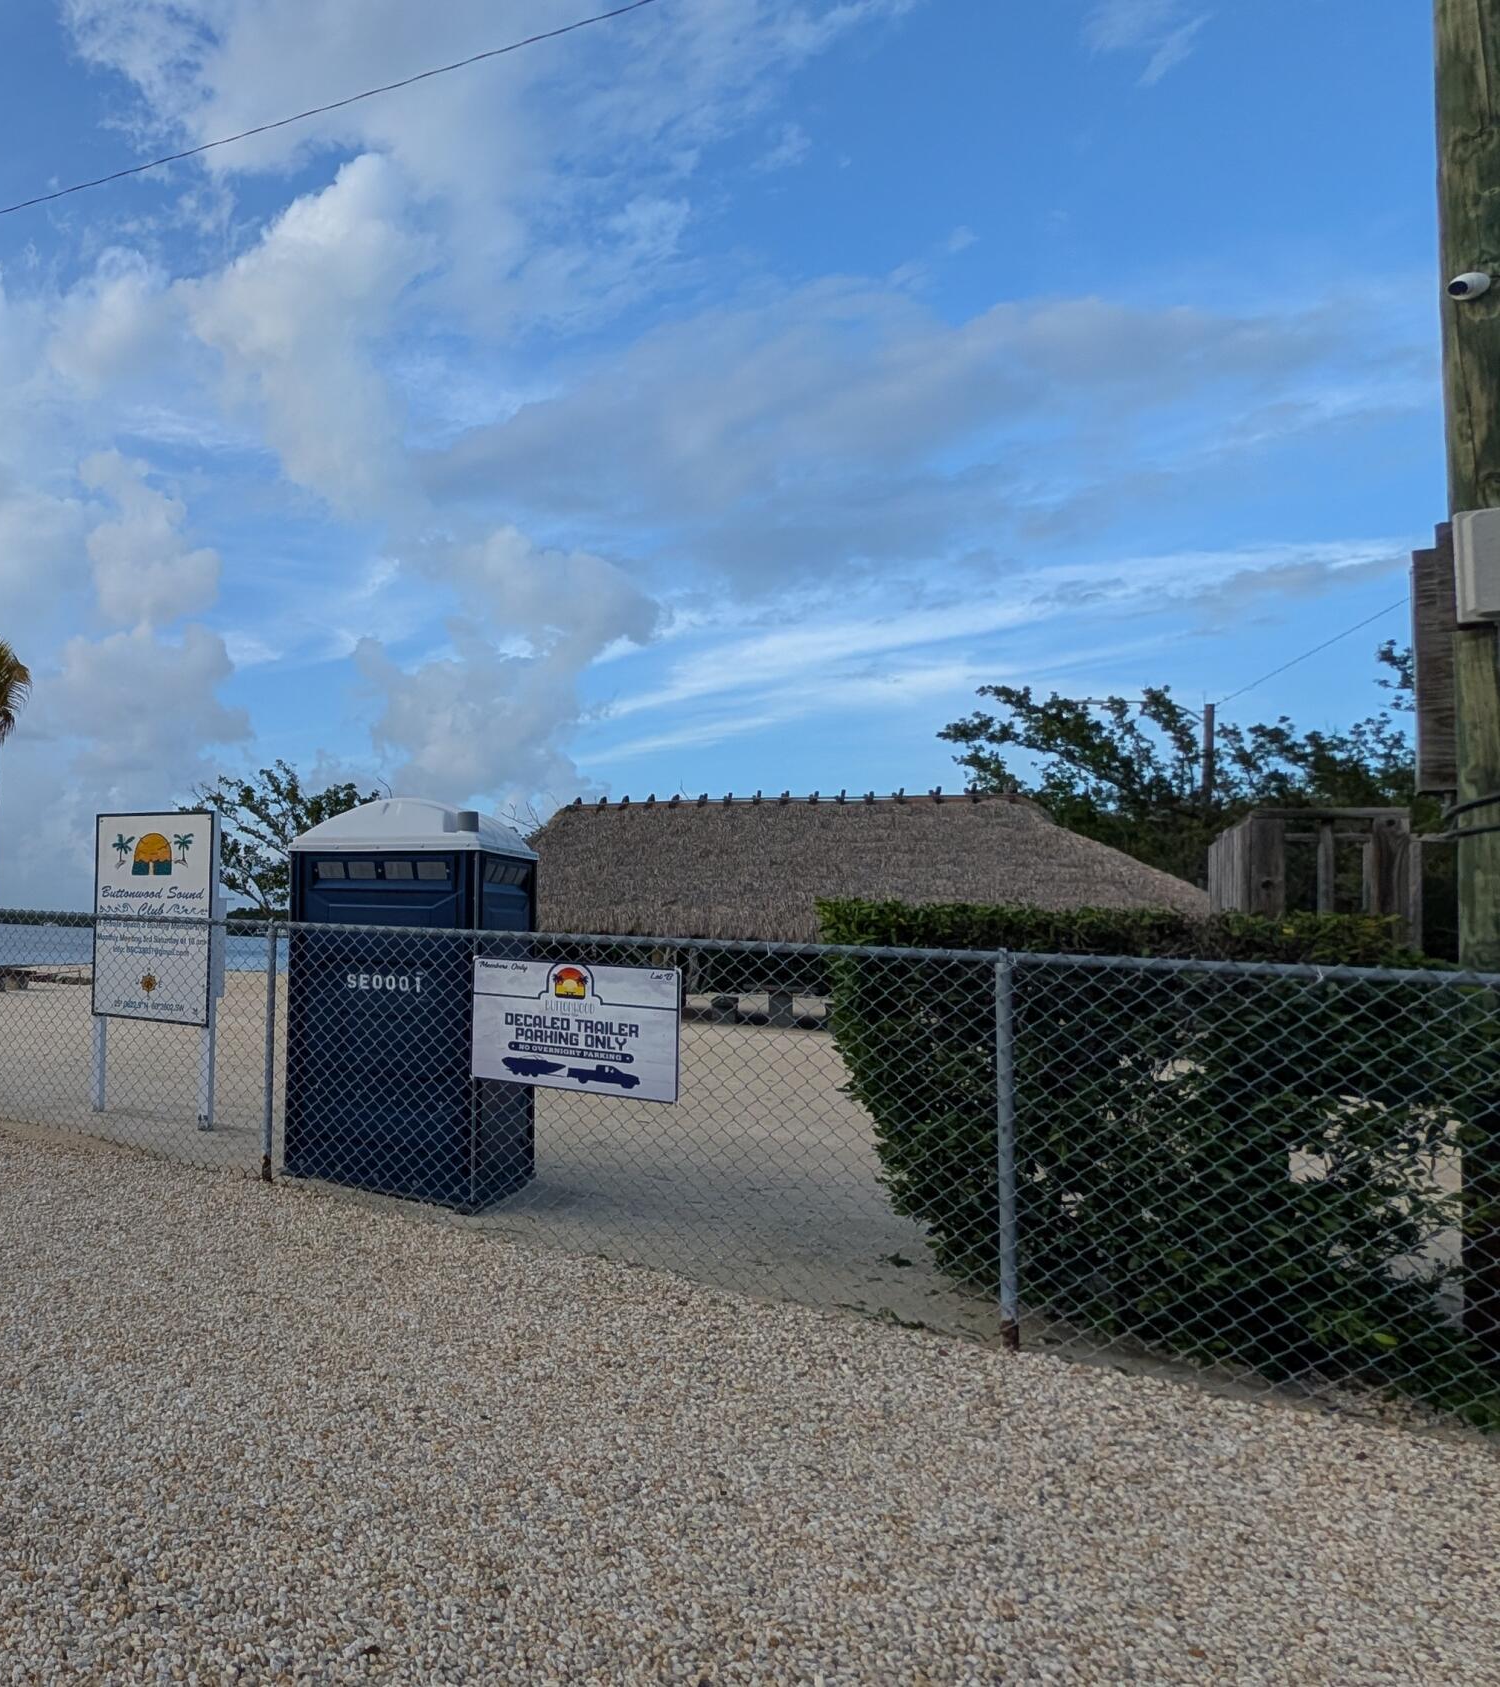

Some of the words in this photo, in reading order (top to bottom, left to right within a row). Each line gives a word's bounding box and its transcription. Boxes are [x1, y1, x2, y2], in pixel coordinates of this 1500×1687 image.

[101, 885, 163, 899] Buttonwood
[166, 886, 205, 900] Sound
[137, 902, 165, 916] Club
[478, 960, 508, 970] Members
[510, 962, 528, 973] Only
[650, 971, 663, 980] Lot
[504, 1012, 571, 1031] DECALED
[574, 1018, 640, 1038] TRAILER
[515, 1027, 580, 1046] PARKING
[584, 1034, 627, 1052] ONLY
[518, 1043, 530, 1051] NO
[531, 1045, 582, 1057] OVERNIGHT
[583, 1050, 622, 1061] PARKING
